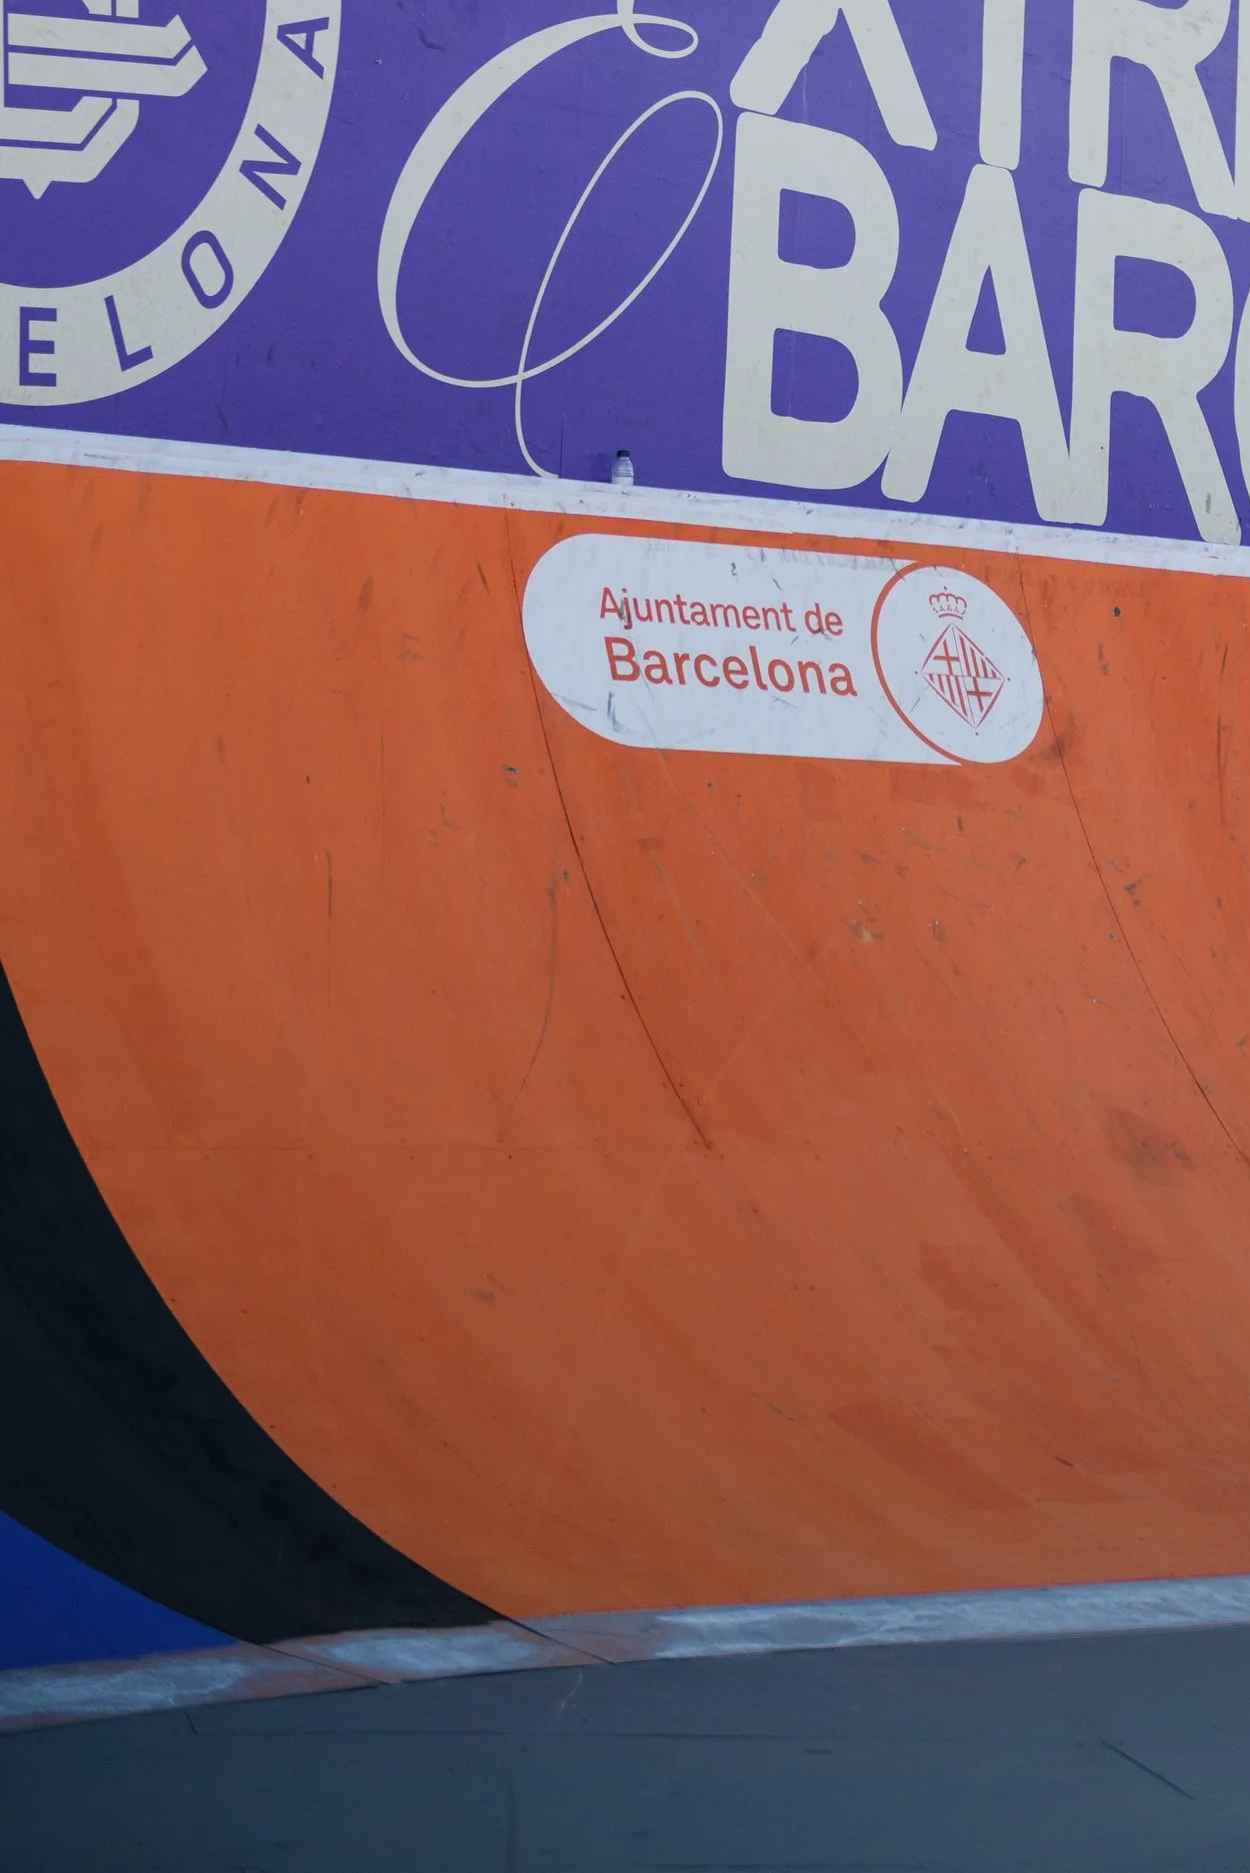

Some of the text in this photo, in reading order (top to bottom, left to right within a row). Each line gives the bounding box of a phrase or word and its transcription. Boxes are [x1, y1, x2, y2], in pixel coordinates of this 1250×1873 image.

[600, 586, 844, 636] Ajuntament de
[604, 636, 858, 698] Barcelona
